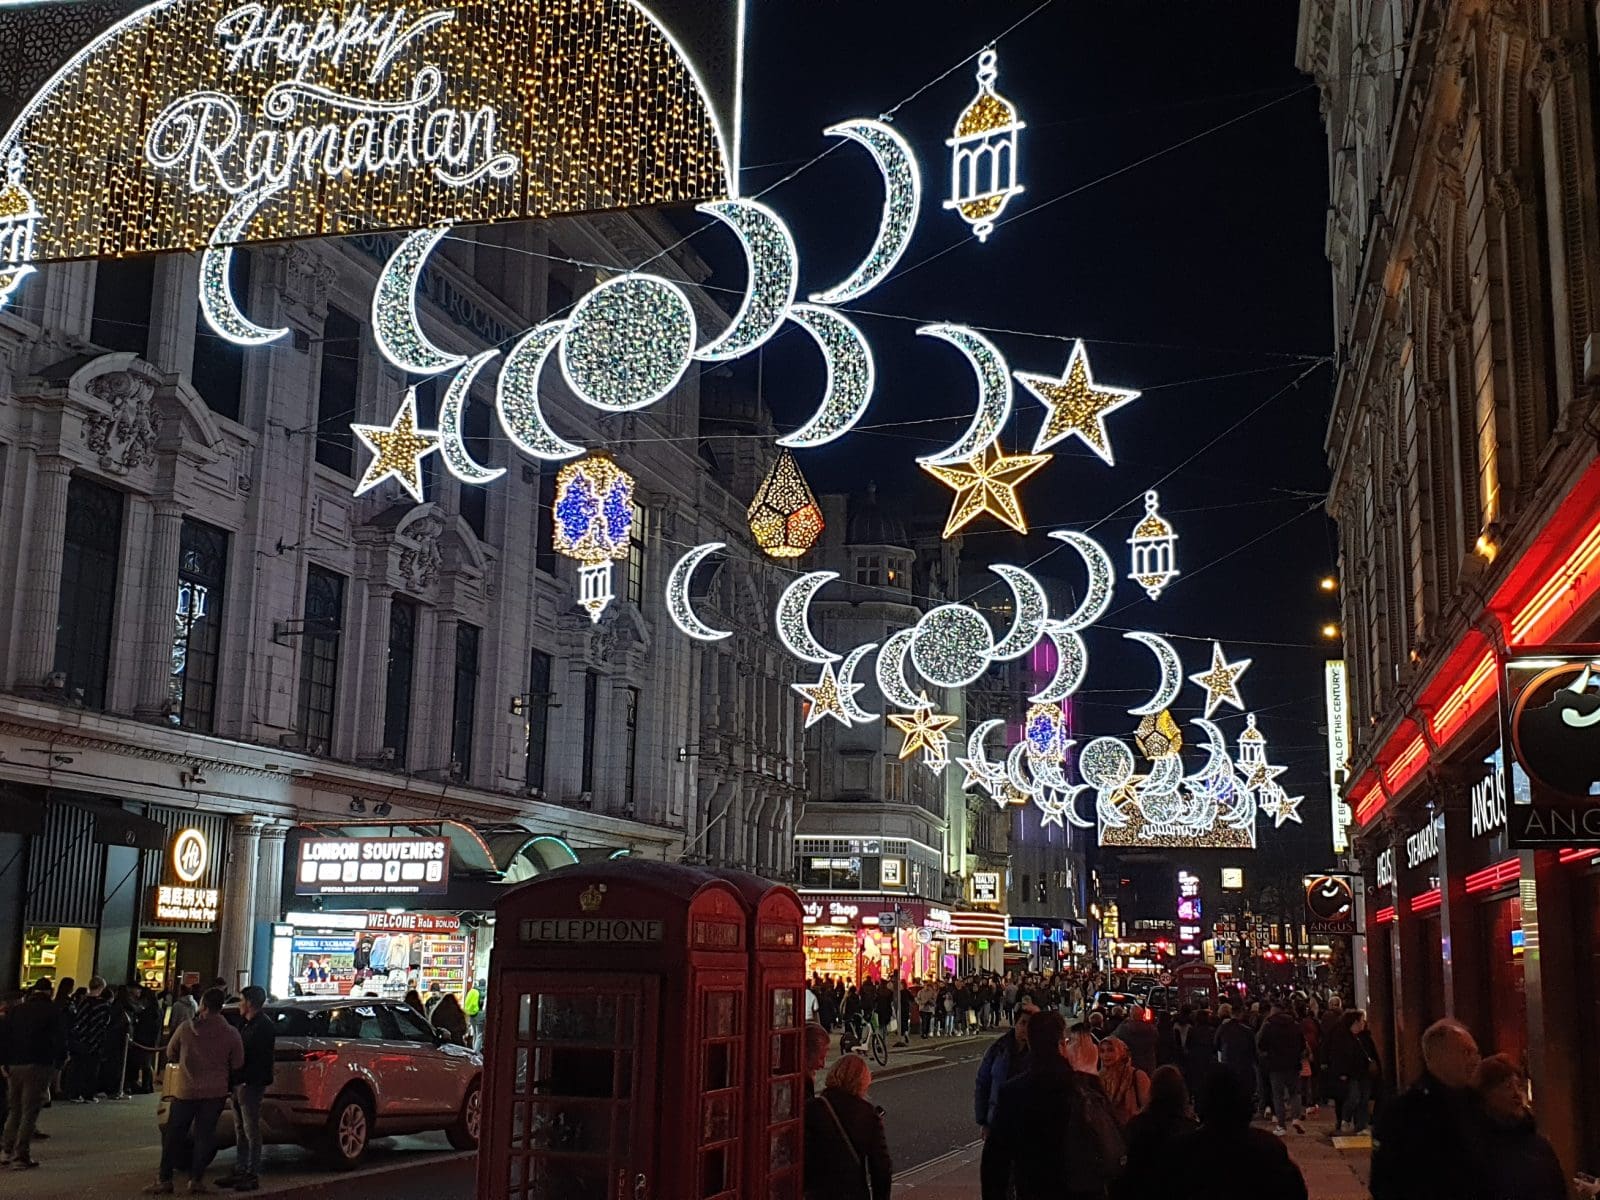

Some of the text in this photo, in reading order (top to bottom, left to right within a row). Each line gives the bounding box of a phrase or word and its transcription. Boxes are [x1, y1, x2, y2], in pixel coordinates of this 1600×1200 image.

[214, 1, 455, 84] Happy
[145, 66, 518, 194] Ramadan
[1333, 714, 1343, 735] THIS
[1334, 735, 1344, 749] OF
[1471, 771, 1507, 838] ANGUS
[302, 842, 445, 860] LONDON SOUVENIRS
[189, 907, 202, 920] Hot
[203, 908, 216, 921] Pot
[830, 902, 858, 919] Shop
[368, 913, 460, 929] WELCOME Hola BONJOU
[523, 920, 658, 940] TELEPHONE
[1310, 922, 1353, 931] ANGUS
